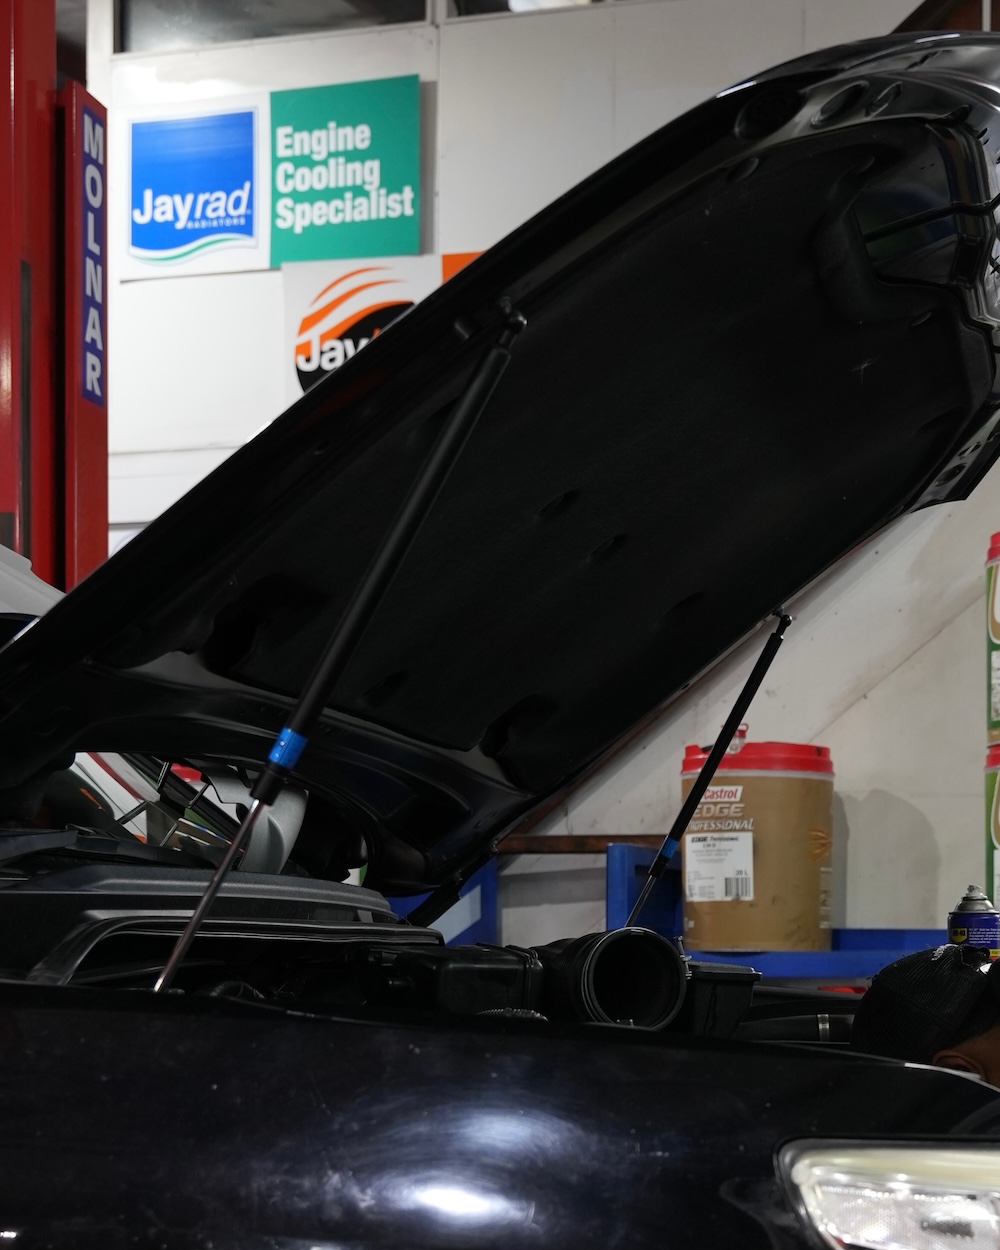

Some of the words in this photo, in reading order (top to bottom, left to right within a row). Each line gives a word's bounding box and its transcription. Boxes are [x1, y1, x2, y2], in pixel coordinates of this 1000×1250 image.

[275, 121, 371, 162] Engine
[275, 156, 381, 194] Cooling
[132, 181, 251, 230] Jayrad
[275, 184, 414, 234] Specialist
[83, 112, 104, 397] MOLNAR
[296, 334, 369, 373] Jay
[694, 803, 745, 817] EDGE
[704, 788, 738, 800] Castrol
